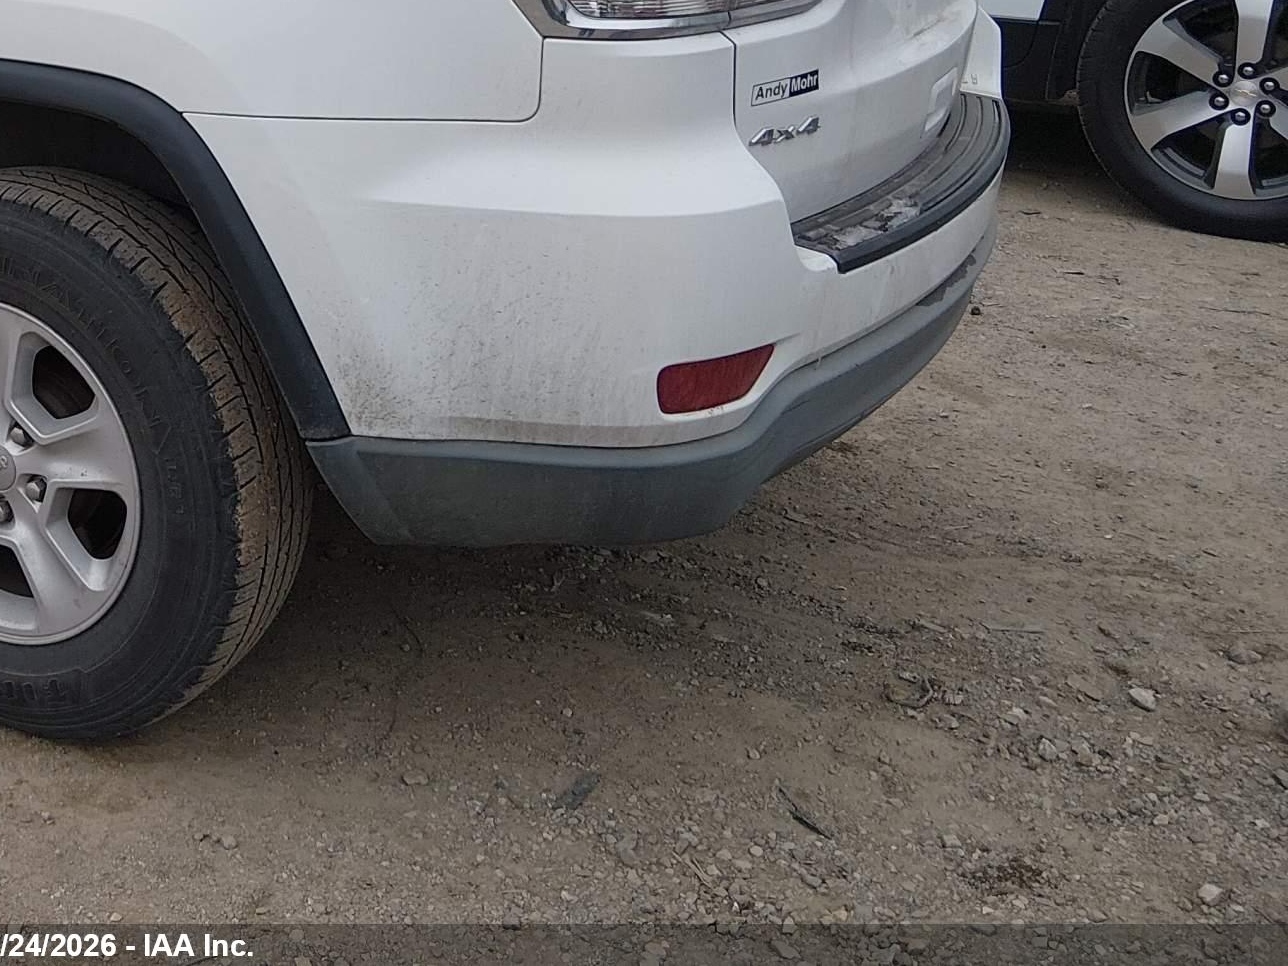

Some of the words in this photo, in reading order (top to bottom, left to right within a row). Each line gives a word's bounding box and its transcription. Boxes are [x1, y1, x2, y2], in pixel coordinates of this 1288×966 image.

[755, 82, 788, 101] Andy
[790, 74, 818, 93] Mohr
[748, 115, 821, 147] 4x4
